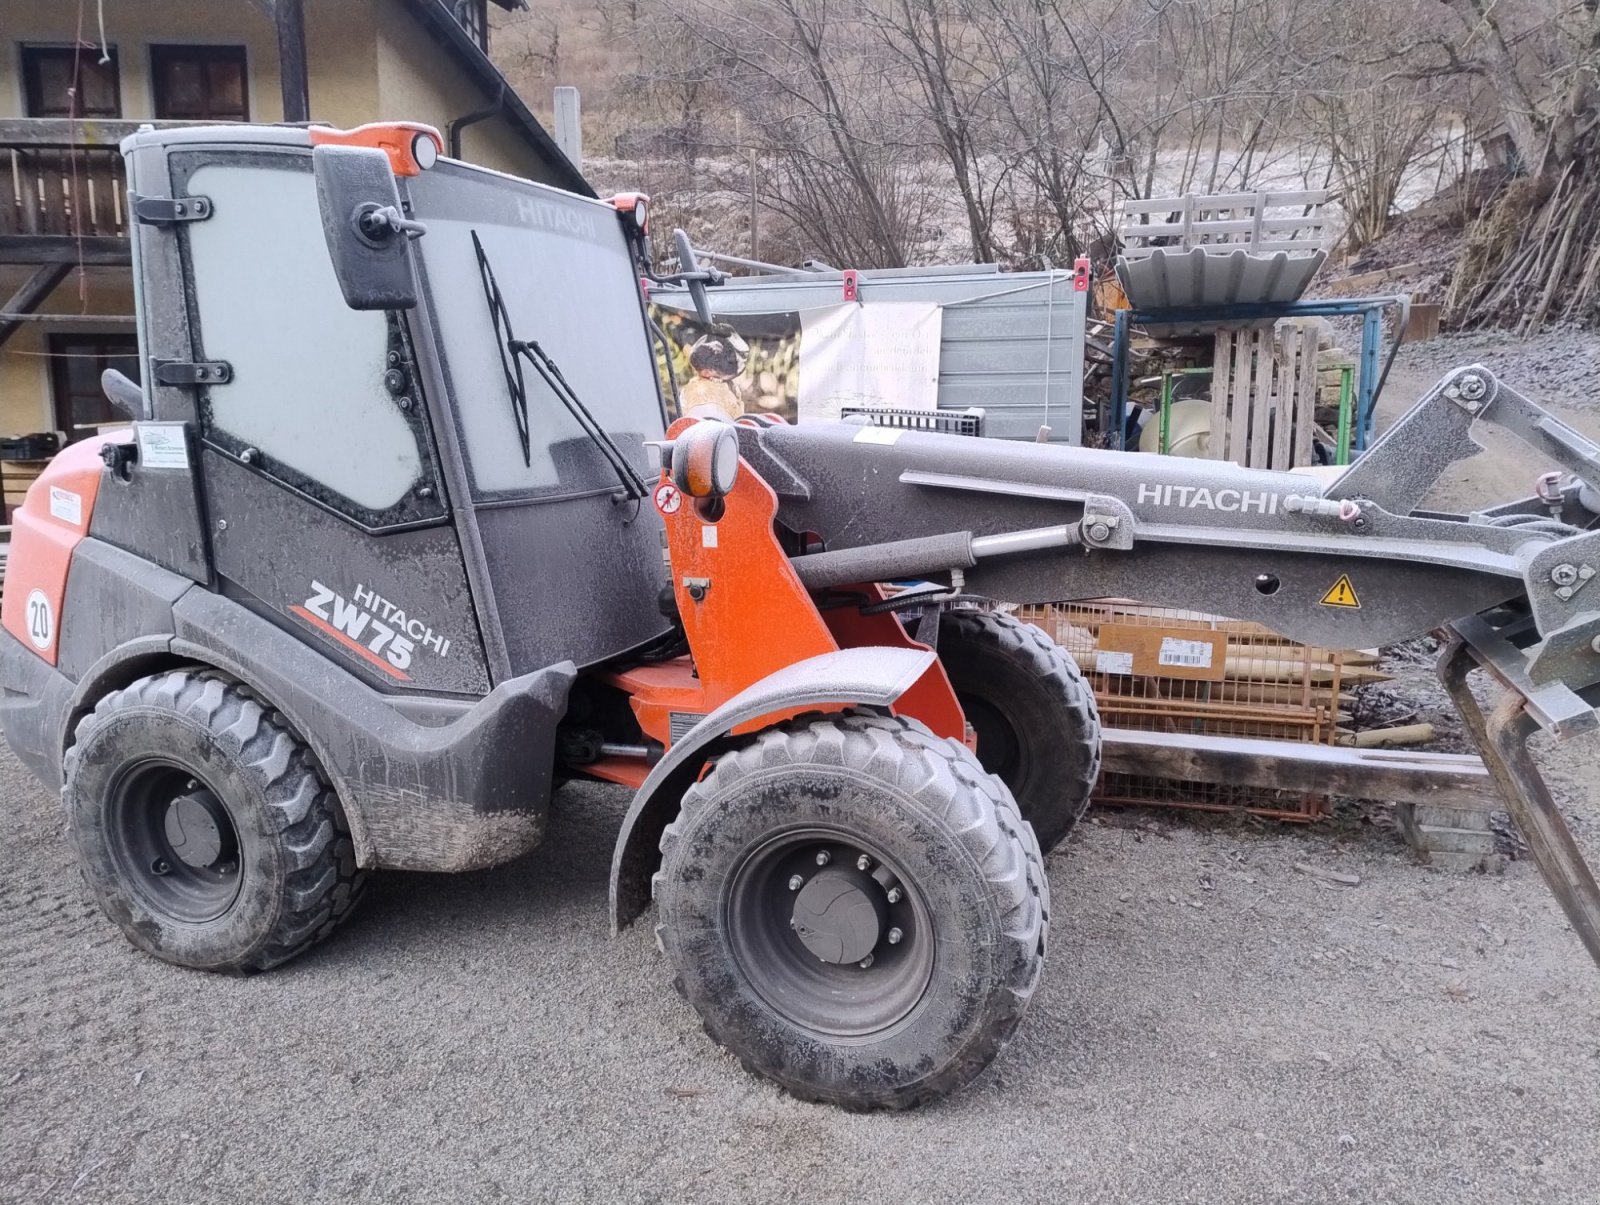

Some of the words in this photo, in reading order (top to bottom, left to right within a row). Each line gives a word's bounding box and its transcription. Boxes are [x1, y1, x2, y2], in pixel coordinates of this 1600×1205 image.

[517, 197, 597, 239] HITACHI
[1137, 483, 1278, 515] HITACHI
[30, 600, 48, 639] 20
[304, 579, 415, 670] ZW75
[353, 583, 450, 658] HITACHI
